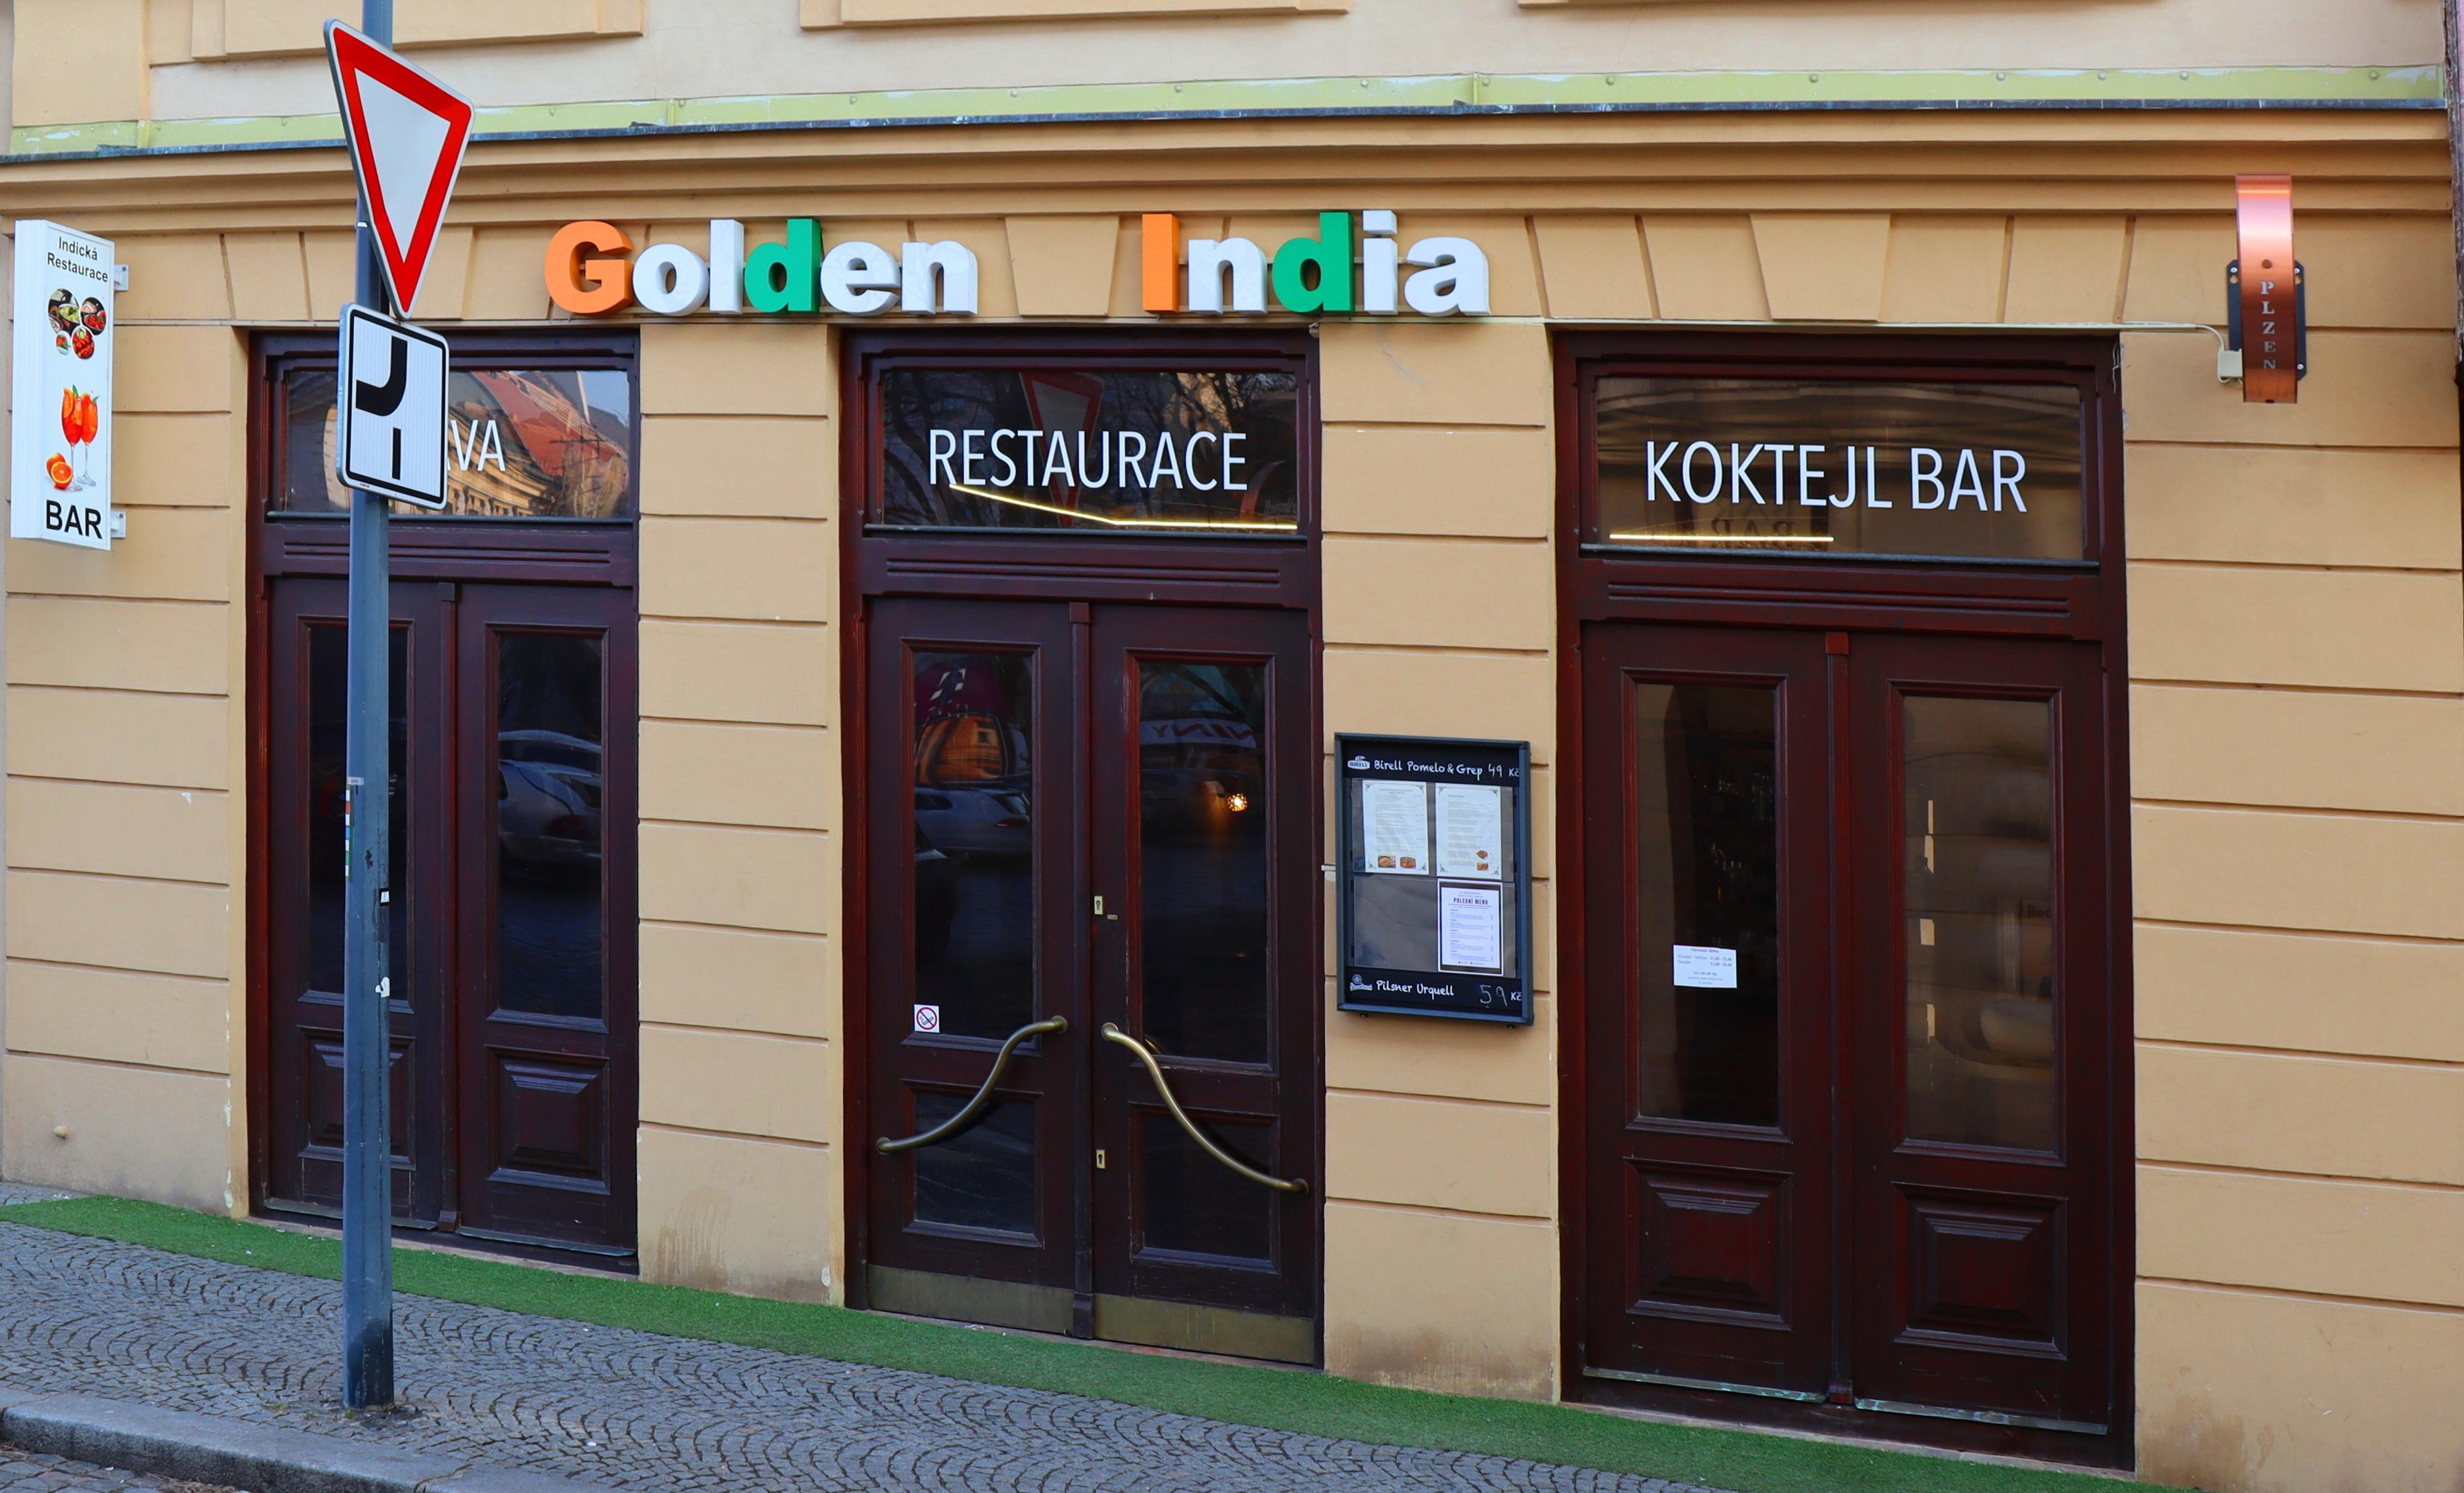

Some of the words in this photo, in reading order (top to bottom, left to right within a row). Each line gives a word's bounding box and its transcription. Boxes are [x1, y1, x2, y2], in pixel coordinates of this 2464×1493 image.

[47, 251, 108, 282] Restaurace
[59, 236, 98, 261] Indická
[544, 218, 978, 317] Golden
[1141, 210, 1491, 317] India
[448, 420, 506, 471] VA
[929, 428, 1247, 490] RESTAURACE
[1646, 441, 1892, 508] KOKTEJL
[1910, 447, 2027, 513] BAR
[46, 499, 103, 539] BAR
[1374, 760, 1403, 770] Birell
[1407, 761, 1445, 773] Pomelo
[1448, 763, 1454, 774] &
[1456, 764, 1483, 781] Grep
[1488, 763, 1502, 777] 49
[1509, 767, 1520, 777] Kč
[1376, 980, 1412, 993] Pilsner
[1417, 983, 1454, 1000] Urquell
[1479, 984, 1508, 1007] 59
[1510, 991, 1522, 1001] Kč
